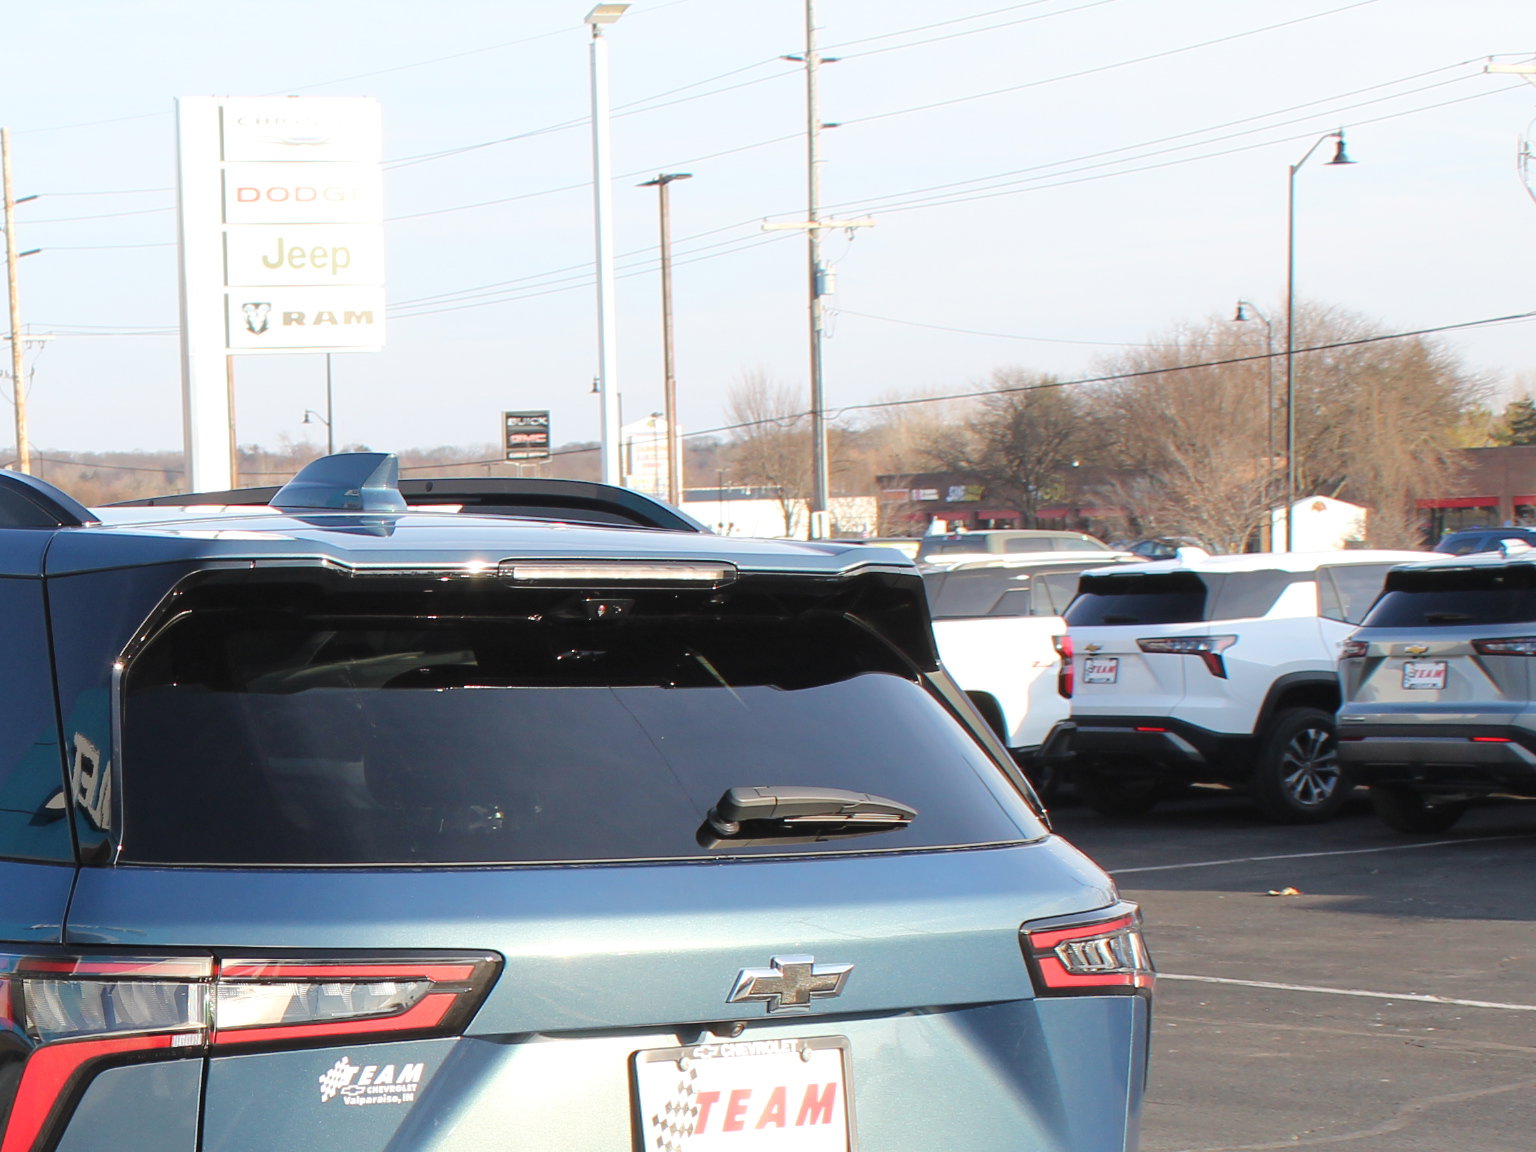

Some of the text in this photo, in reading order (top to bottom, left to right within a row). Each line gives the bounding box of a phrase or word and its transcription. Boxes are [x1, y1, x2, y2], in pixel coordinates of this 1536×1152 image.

[262, 237, 351, 275] Jeep
[282, 310, 374, 326] RAM
[720, 1040, 799, 1057] CHEVROLET
[344, 1063, 424, 1086] TEAM
[367, 1084, 417, 1094] CHEVROLET
[344, 1092, 414, 1106] Valparaiso, IN
[694, 1082, 837, 1135] TEAM
